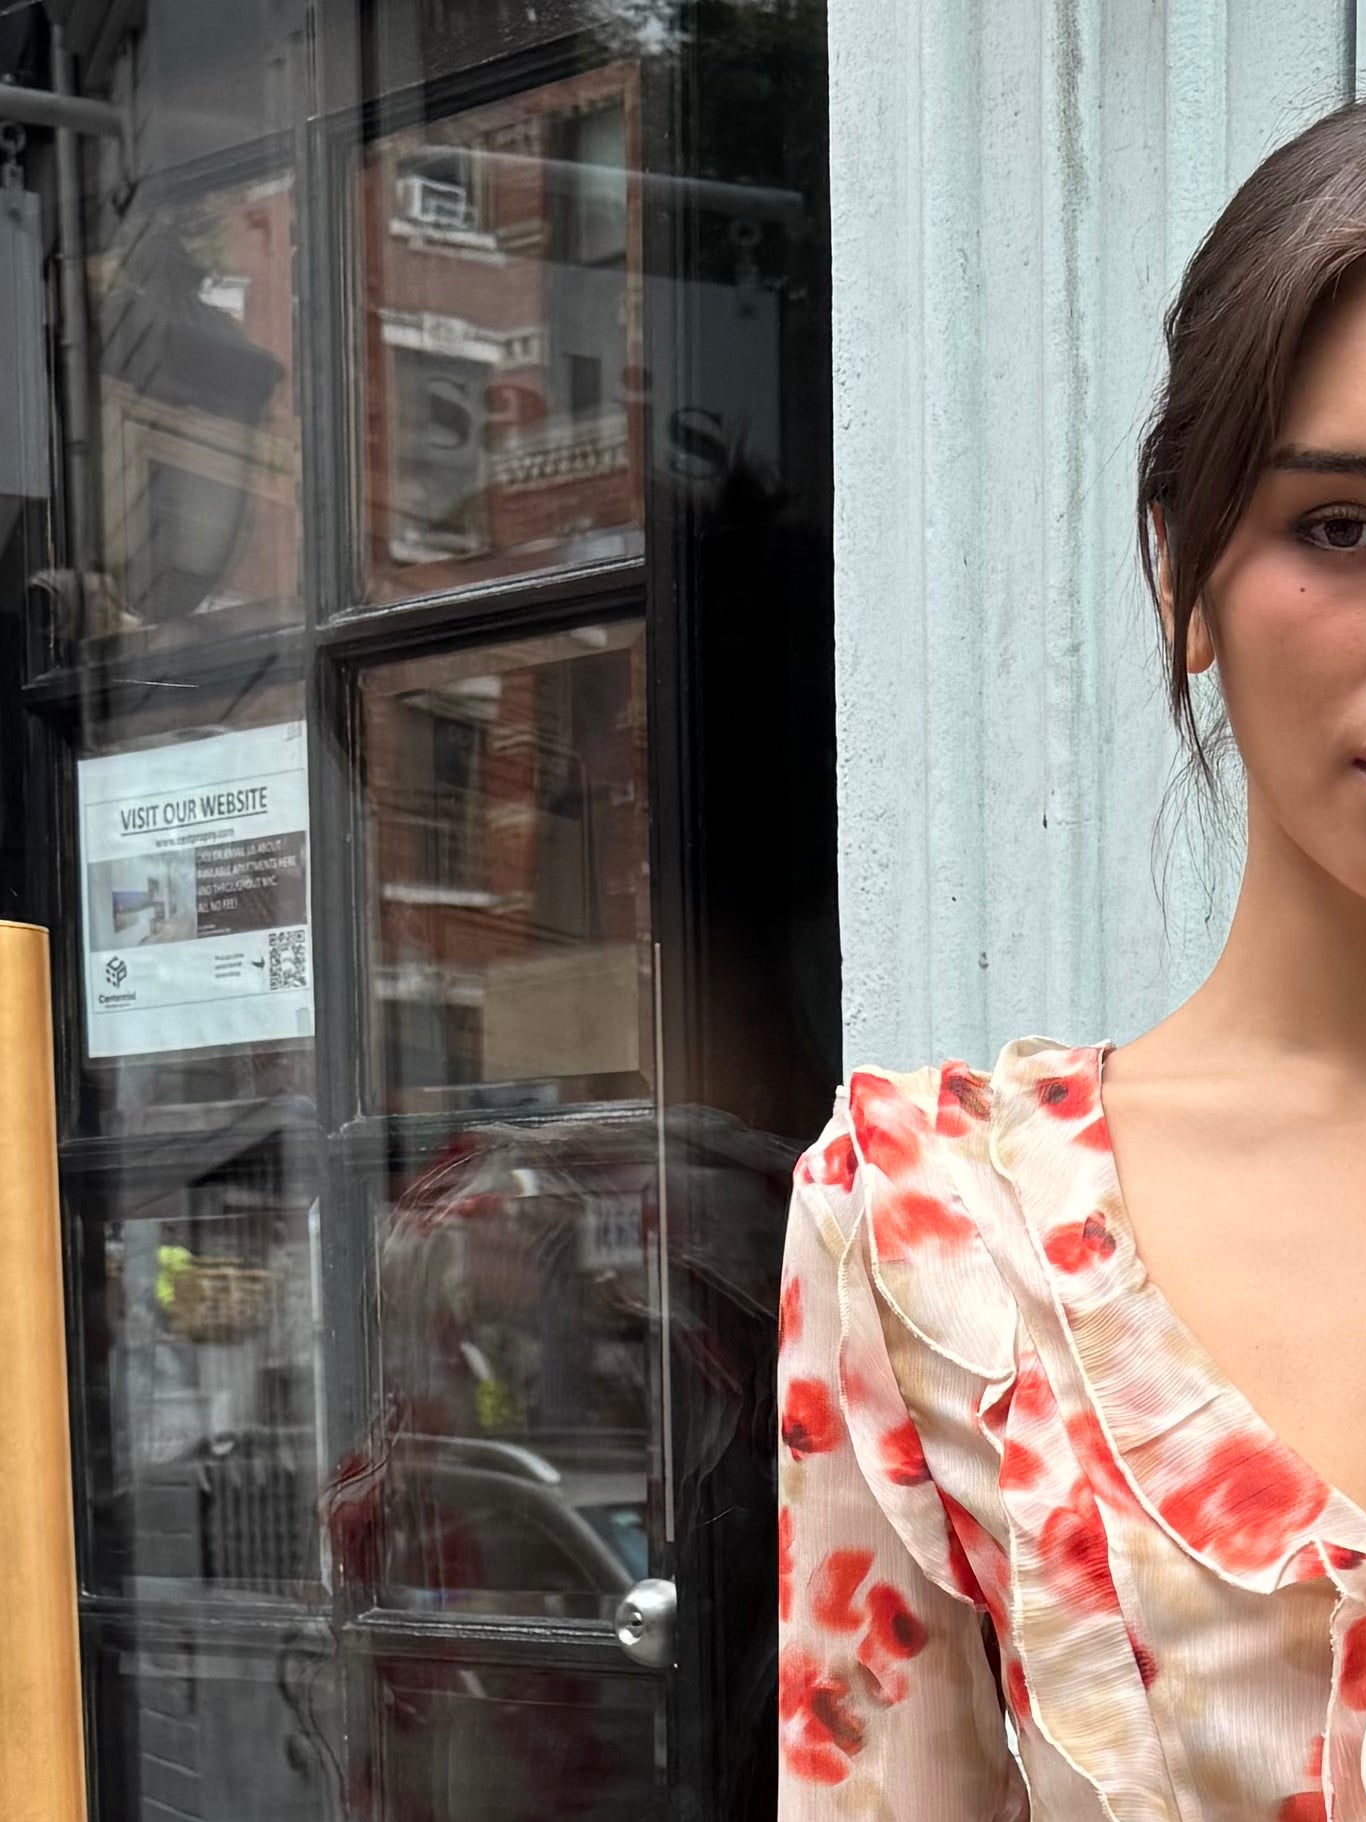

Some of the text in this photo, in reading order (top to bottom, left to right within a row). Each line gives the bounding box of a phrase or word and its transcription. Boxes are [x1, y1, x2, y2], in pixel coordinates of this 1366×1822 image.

[121, 786, 268, 831] VISIT OUR WEBSITE
